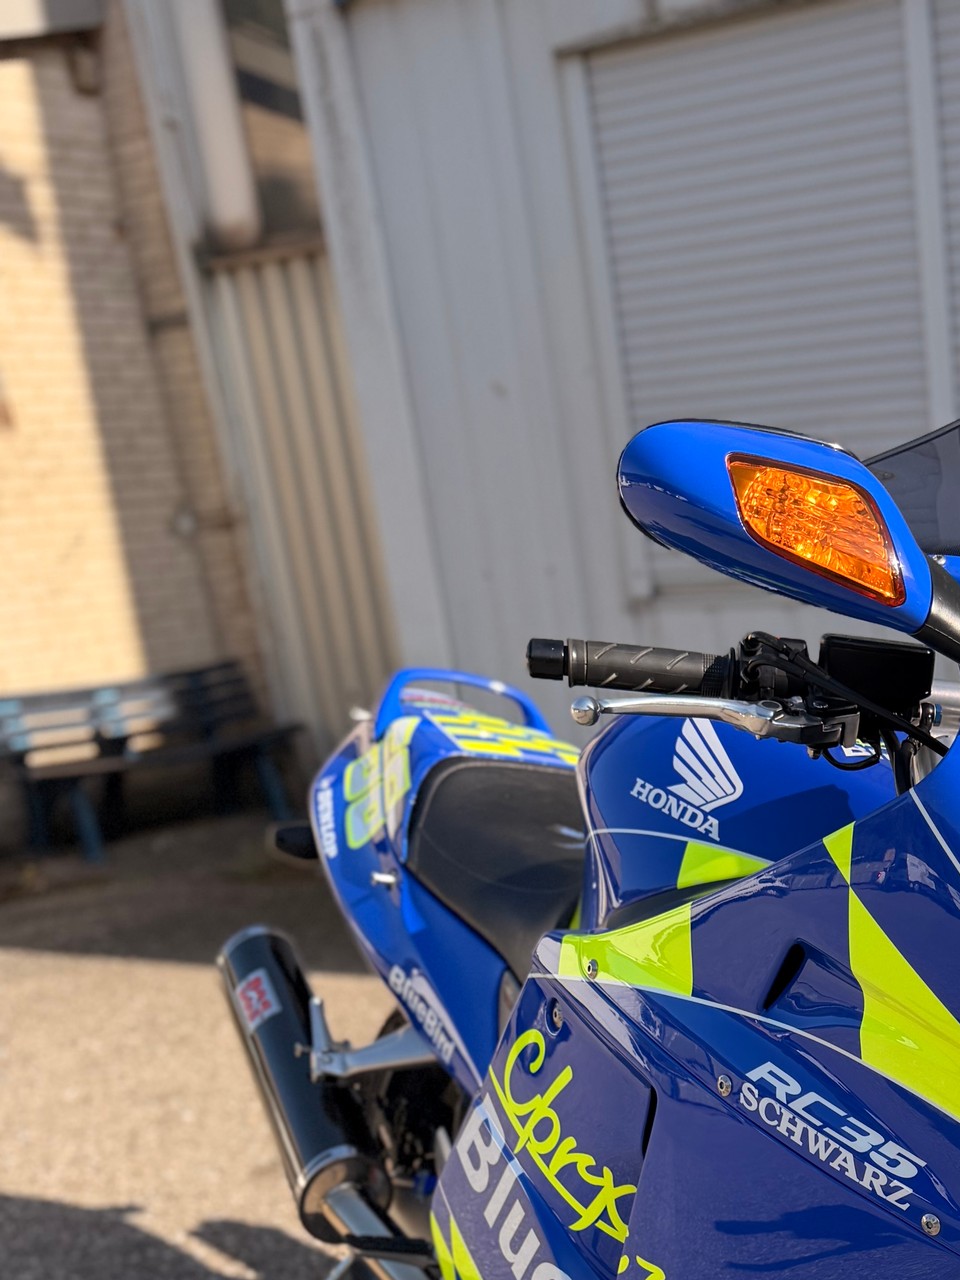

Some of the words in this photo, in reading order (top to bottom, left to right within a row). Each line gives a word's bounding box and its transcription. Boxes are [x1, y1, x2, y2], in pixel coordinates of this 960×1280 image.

[630, 777, 720, 841] HONDA
[389, 964, 456, 1065] BlueBird
[739, 1082, 914, 1211] SCHWARZ
[745, 1061, 928, 1179] RC35
